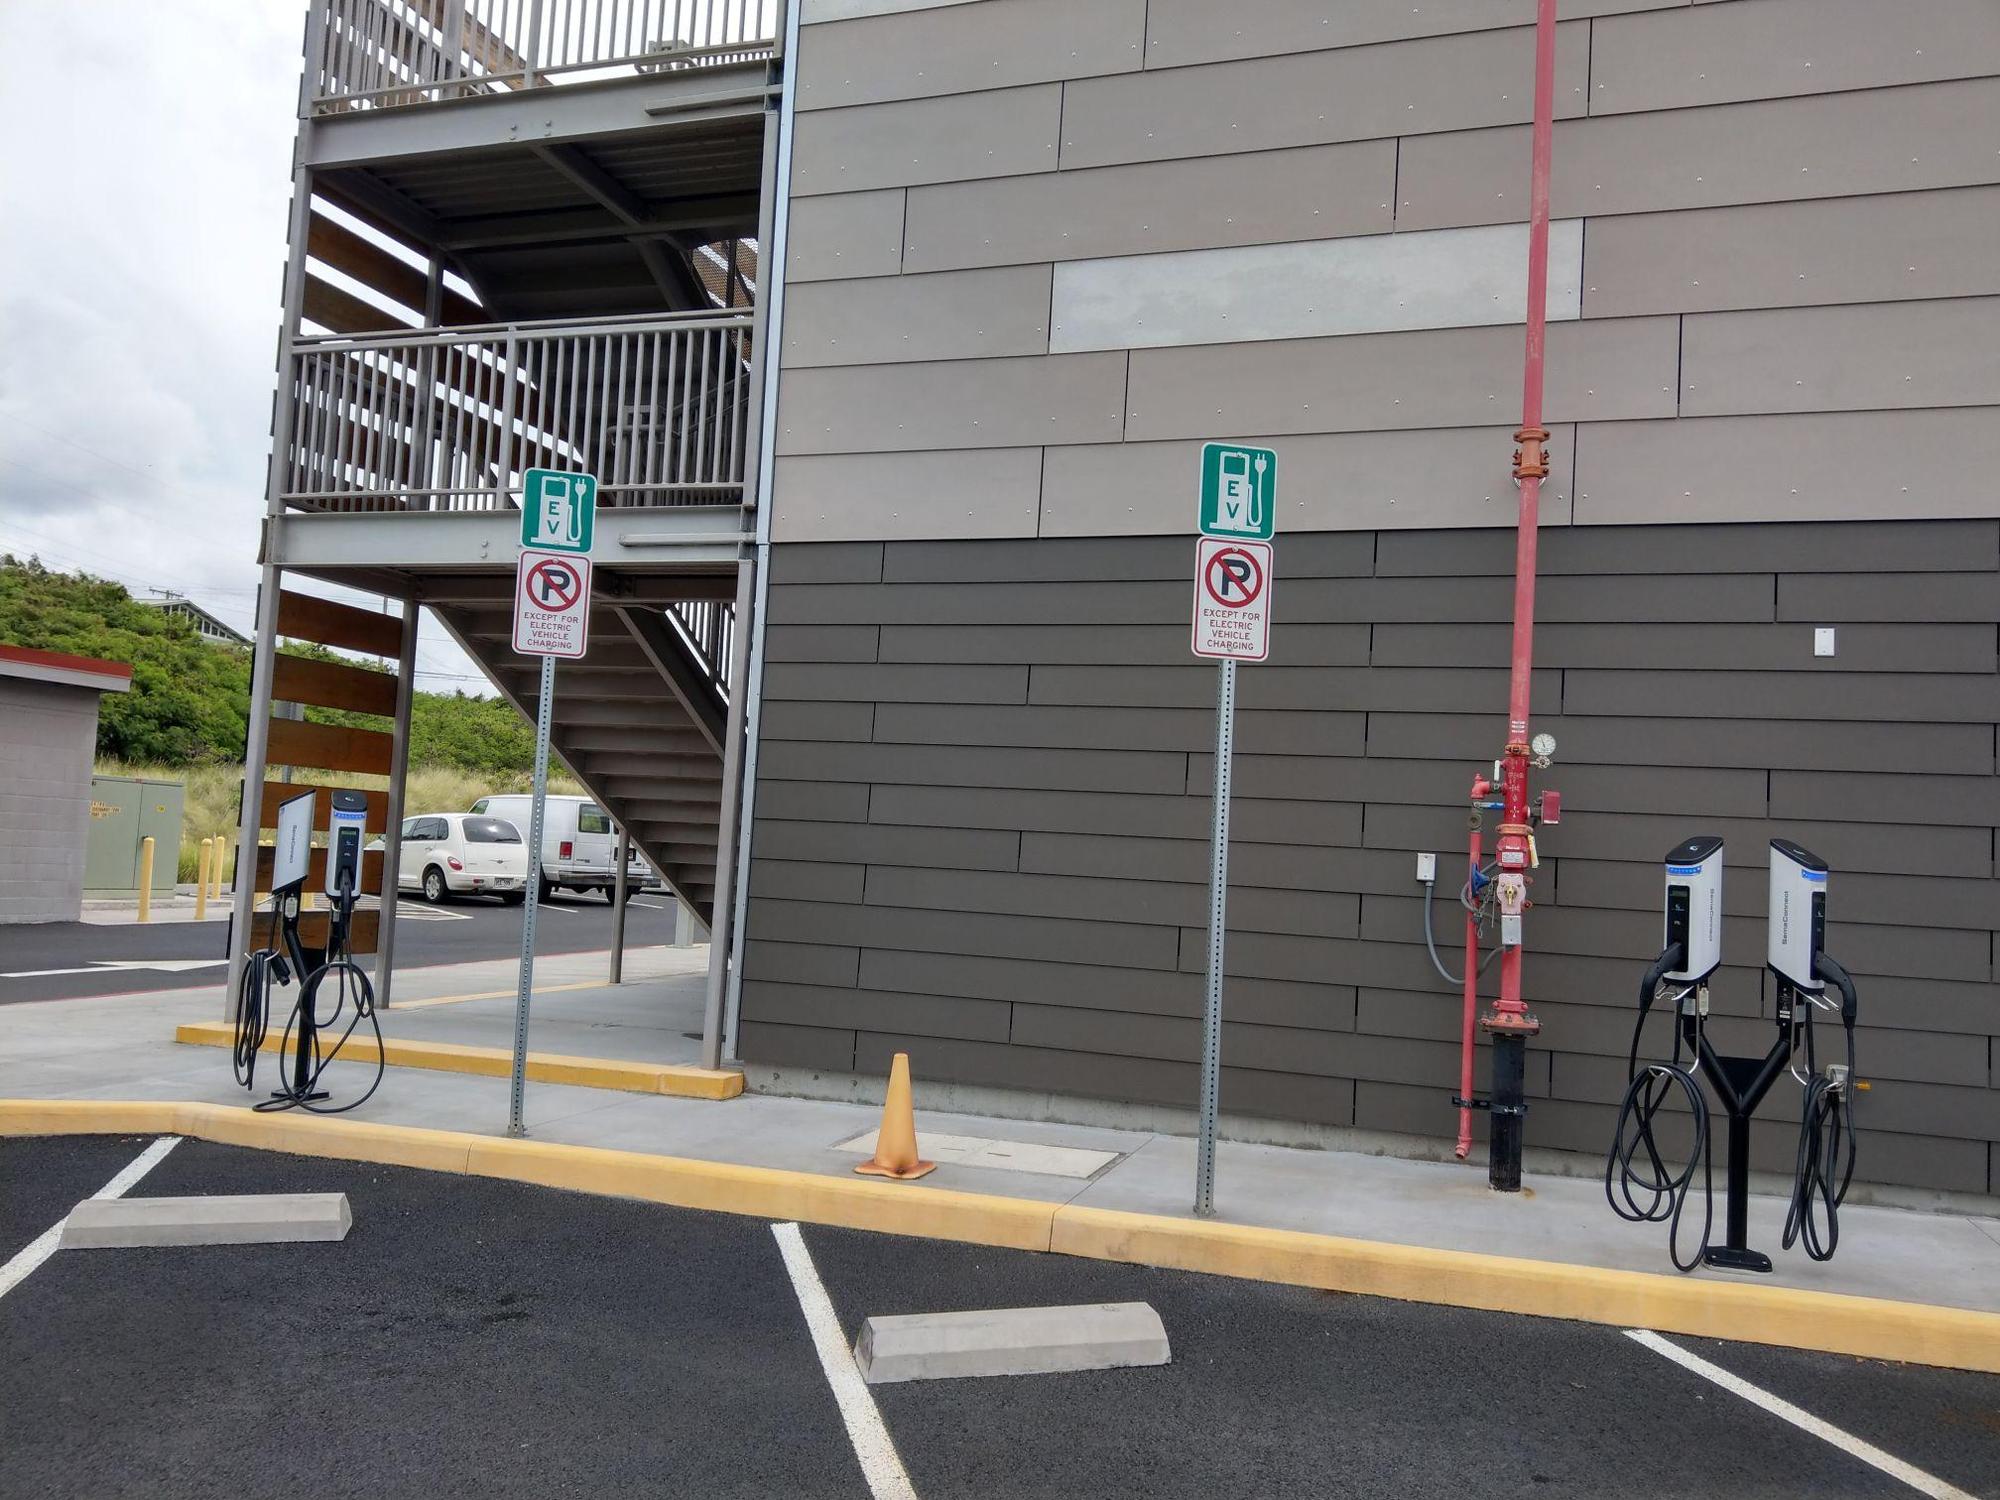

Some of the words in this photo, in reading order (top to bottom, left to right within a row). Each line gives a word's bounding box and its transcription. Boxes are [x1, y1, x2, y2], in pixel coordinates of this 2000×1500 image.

[524, 611, 558, 622] EXCEPT
[561, 615, 579, 624] FOR
[1203, 608, 1238, 619] EXCEPT
[1242, 611, 1260, 621] FOR
[530, 621, 572, 632] ELECTRIC
[1209, 619, 1253, 631] ELECTRIC
[532, 630, 569, 641] VEHICLE
[1211, 629, 1251, 641] VEHICLE
[527, 638, 572, 650] CHARGING
[1206, 639, 1254, 651] CHARGING
